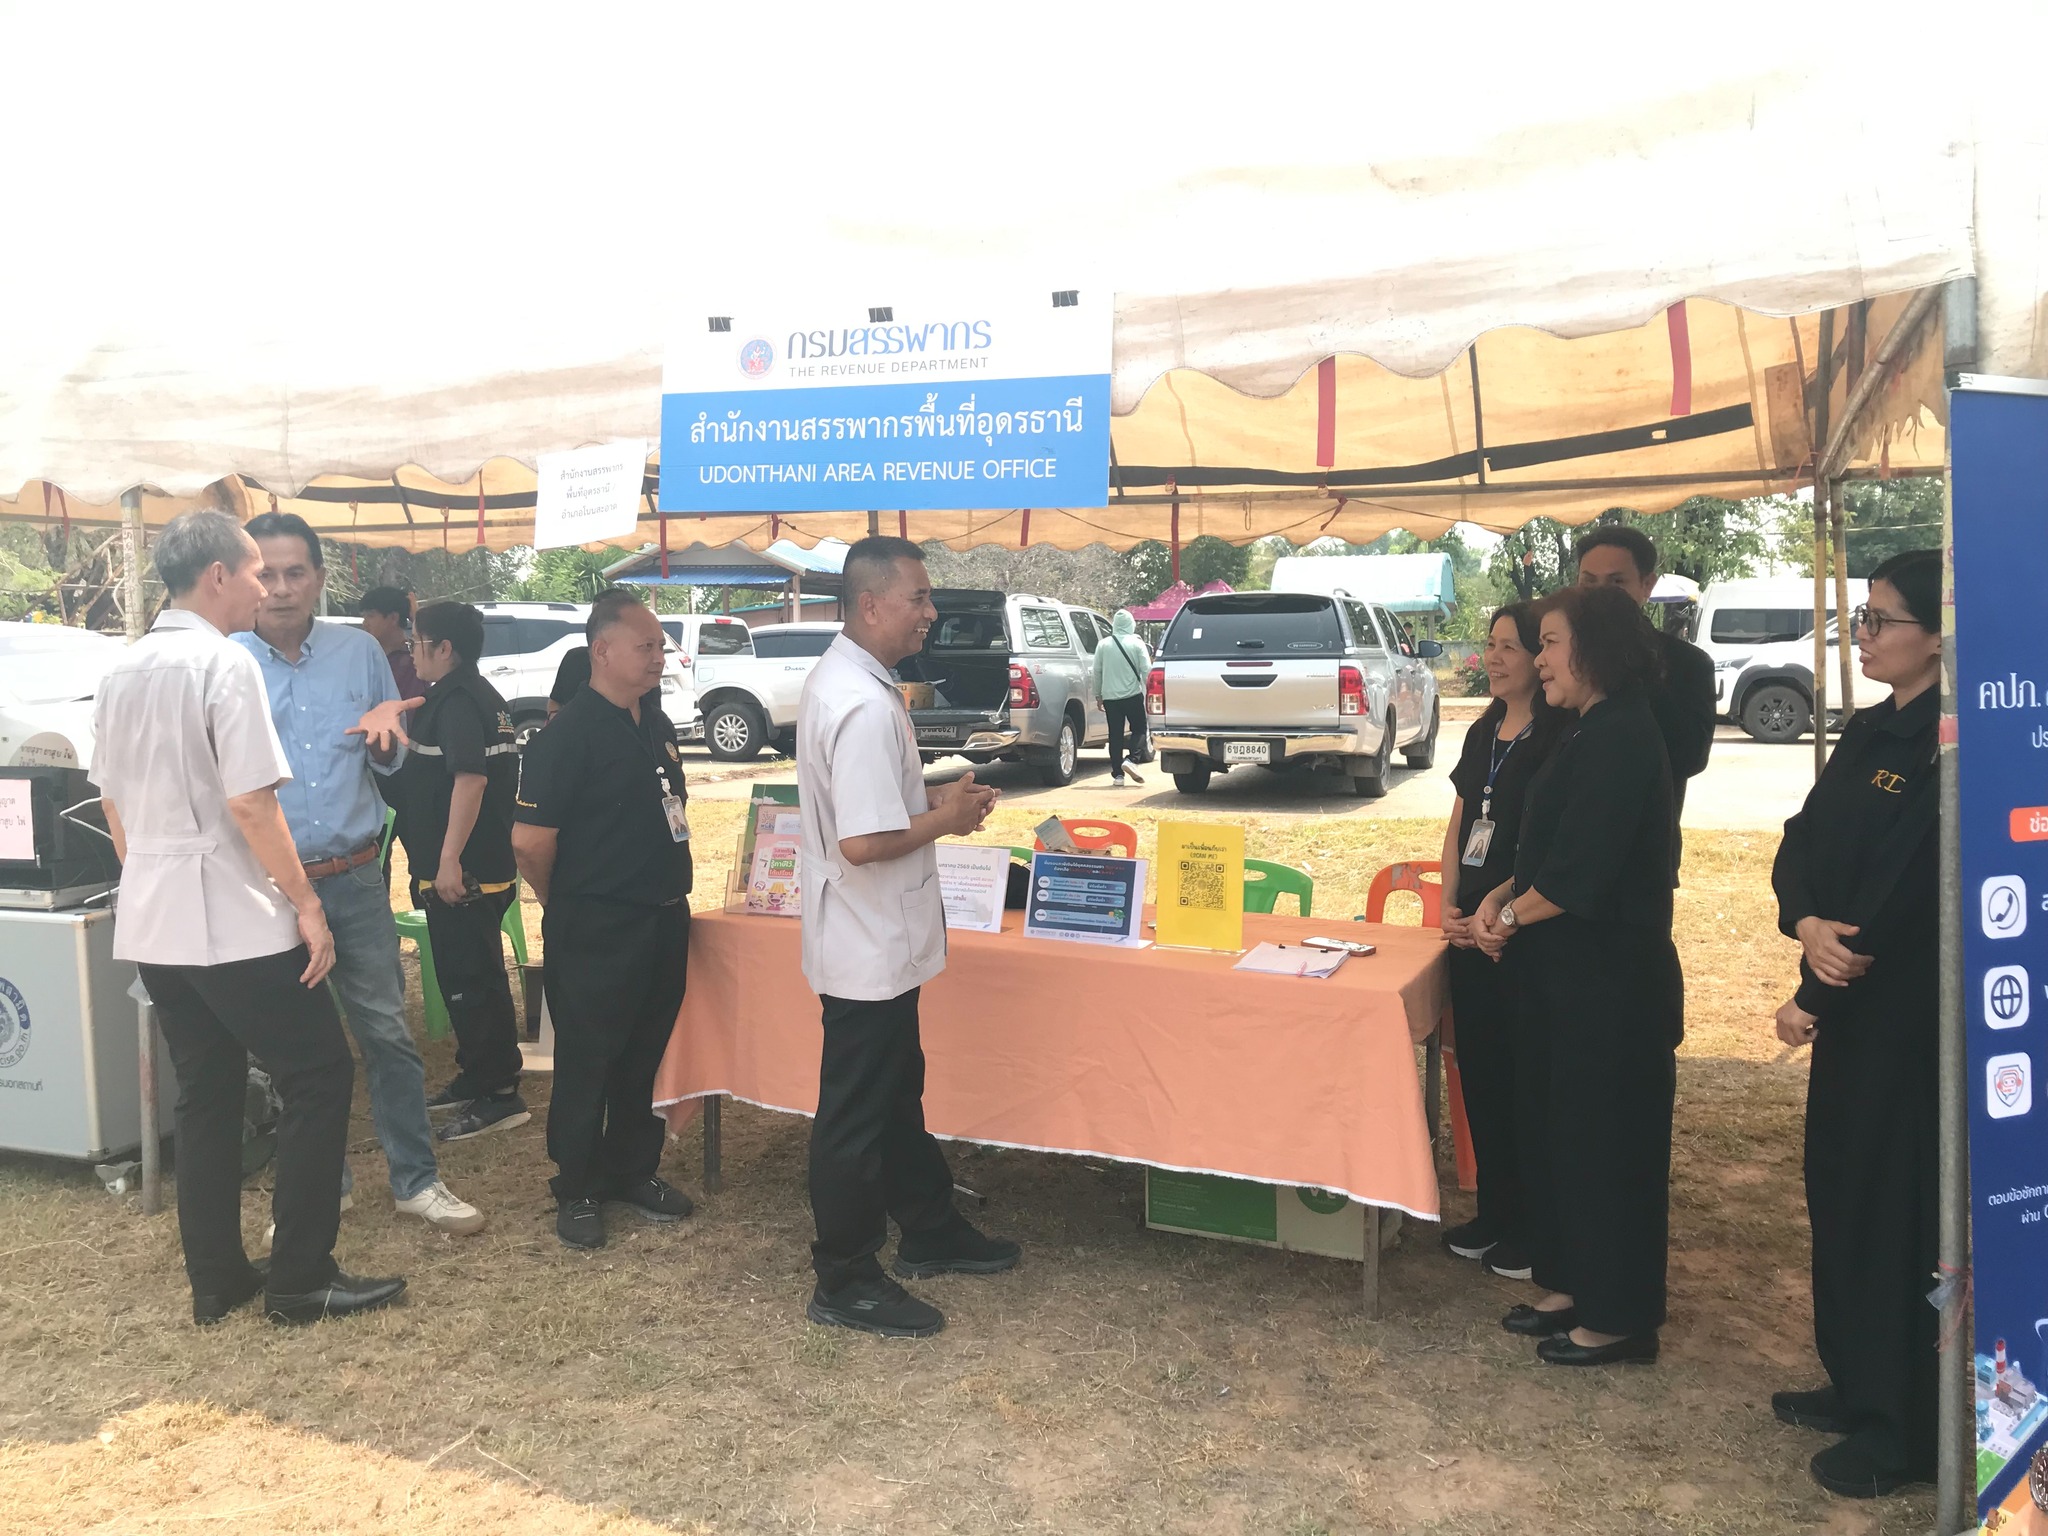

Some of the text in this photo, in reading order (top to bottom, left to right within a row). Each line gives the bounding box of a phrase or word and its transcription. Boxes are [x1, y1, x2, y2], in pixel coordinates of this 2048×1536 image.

[787, 319, 992, 360] กรมสรรพากร
[789, 356, 990, 378] THE REVENUE DEPARTMENT
[690, 392, 1083, 446] สำนักงานสรรพากรพื้นที่อุดรธานี
[560, 462, 624, 481] สำนักงานสรรพากร
[699, 458, 1058, 484] UDONTHANI AREA REVENUE OFFICE
[566, 482, 611, 500] พื้นที่อุดรธานี
[561, 502, 618, 520] อำเภอโนนสะอาด
[1978, 672, 2042, 710] คปภ.
